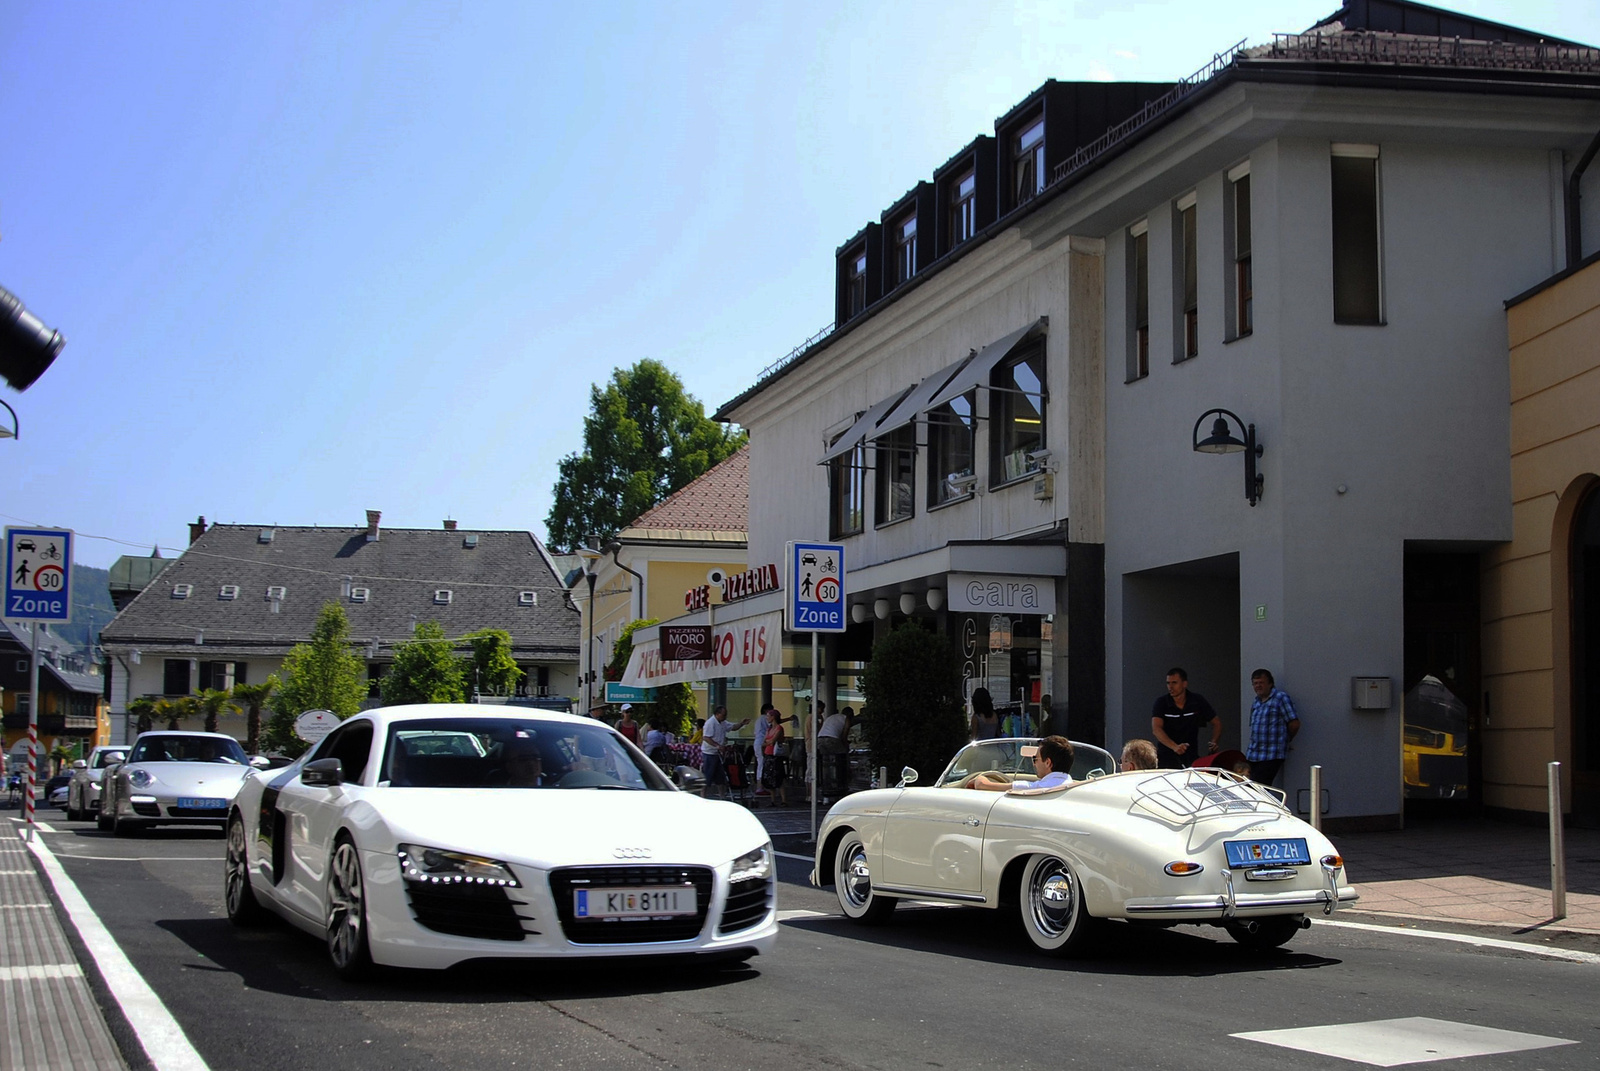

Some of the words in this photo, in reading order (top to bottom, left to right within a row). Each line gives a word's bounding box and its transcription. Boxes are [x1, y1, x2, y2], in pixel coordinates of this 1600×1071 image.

[42, 573, 59, 587] 30
[721, 563, 778, 602] PIZZERIA
[822, 585, 836, 599] 30
[966, 581, 1038, 608] cara
[11, 595, 62, 613] Zone
[799, 607, 838, 623] Zone
[669, 634, 705, 645] MORO
[742, 626, 767, 664] EIS
[1236, 845, 1252, 860] VI
[1262, 844, 1280, 859] 22
[1281, 843, 1299, 858] ZH
[607, 893, 625, 912] KI
